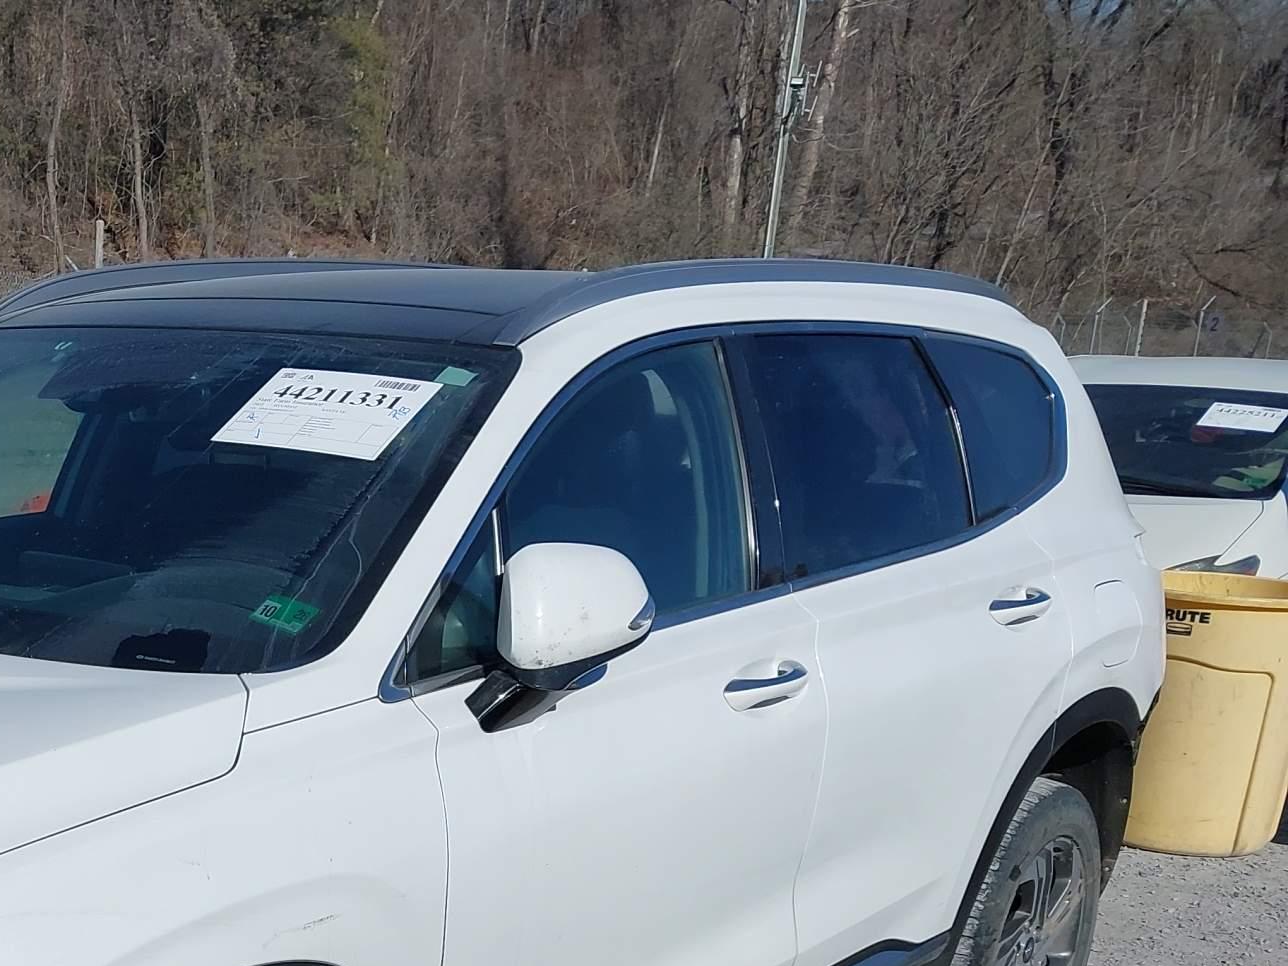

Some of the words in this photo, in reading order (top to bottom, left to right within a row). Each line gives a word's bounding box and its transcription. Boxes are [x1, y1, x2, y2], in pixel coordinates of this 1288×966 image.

[1209, 317, 1219, 332] 2
[273, 385, 404, 410] 44211331
[258, 605, 278, 618] 10
